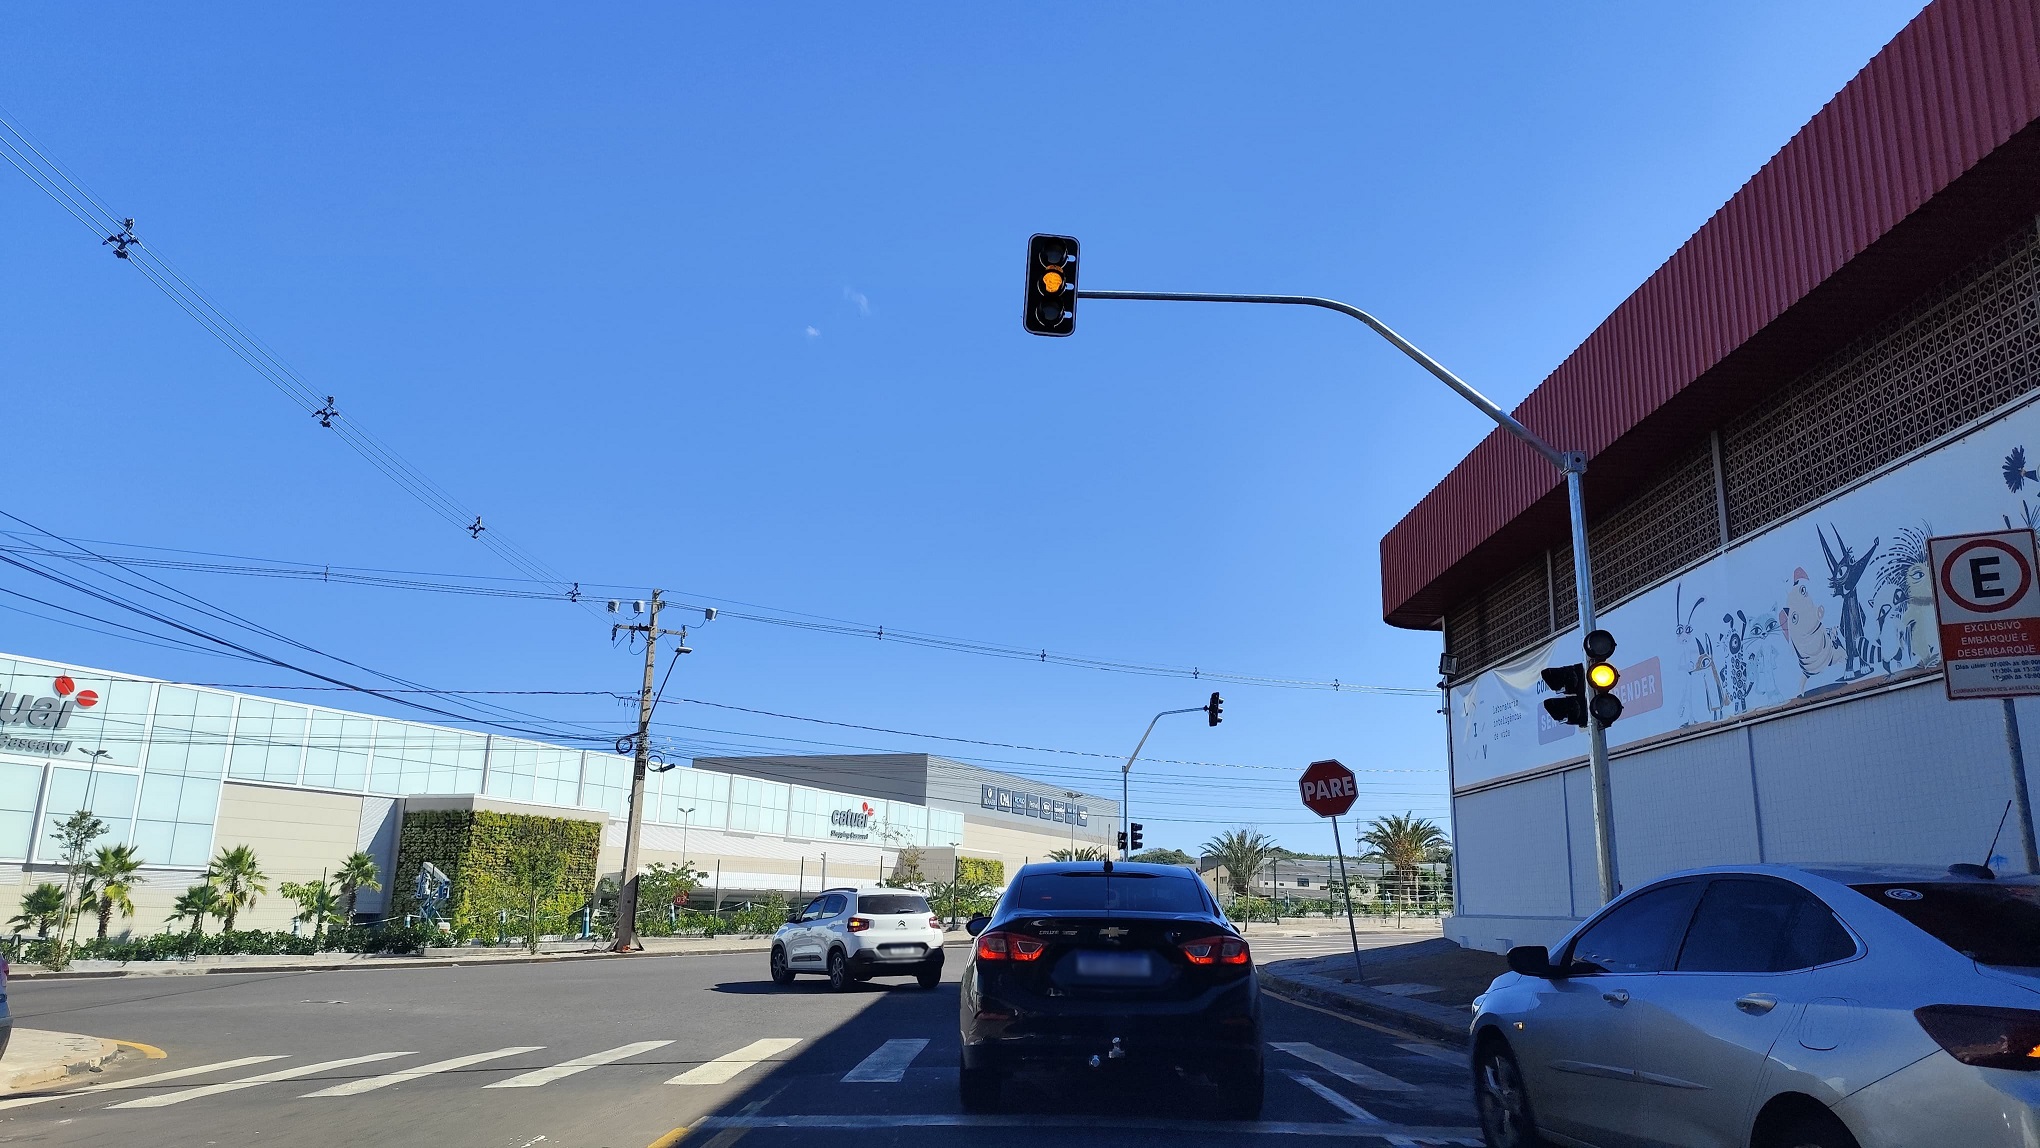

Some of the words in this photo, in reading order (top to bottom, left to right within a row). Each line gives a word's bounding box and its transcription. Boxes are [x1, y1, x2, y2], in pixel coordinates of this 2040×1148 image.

[1969, 556, 2005, 598] E
[1964, 621, 2021, 633] EXCLUSIVO
[1961, 633, 2019, 645] EMBARQUE
[2021, 633, 2028, 641] E
[1957, 645, 2036, 657] DESEMBARQUE
[1303, 776, 1355, 801] PARE
